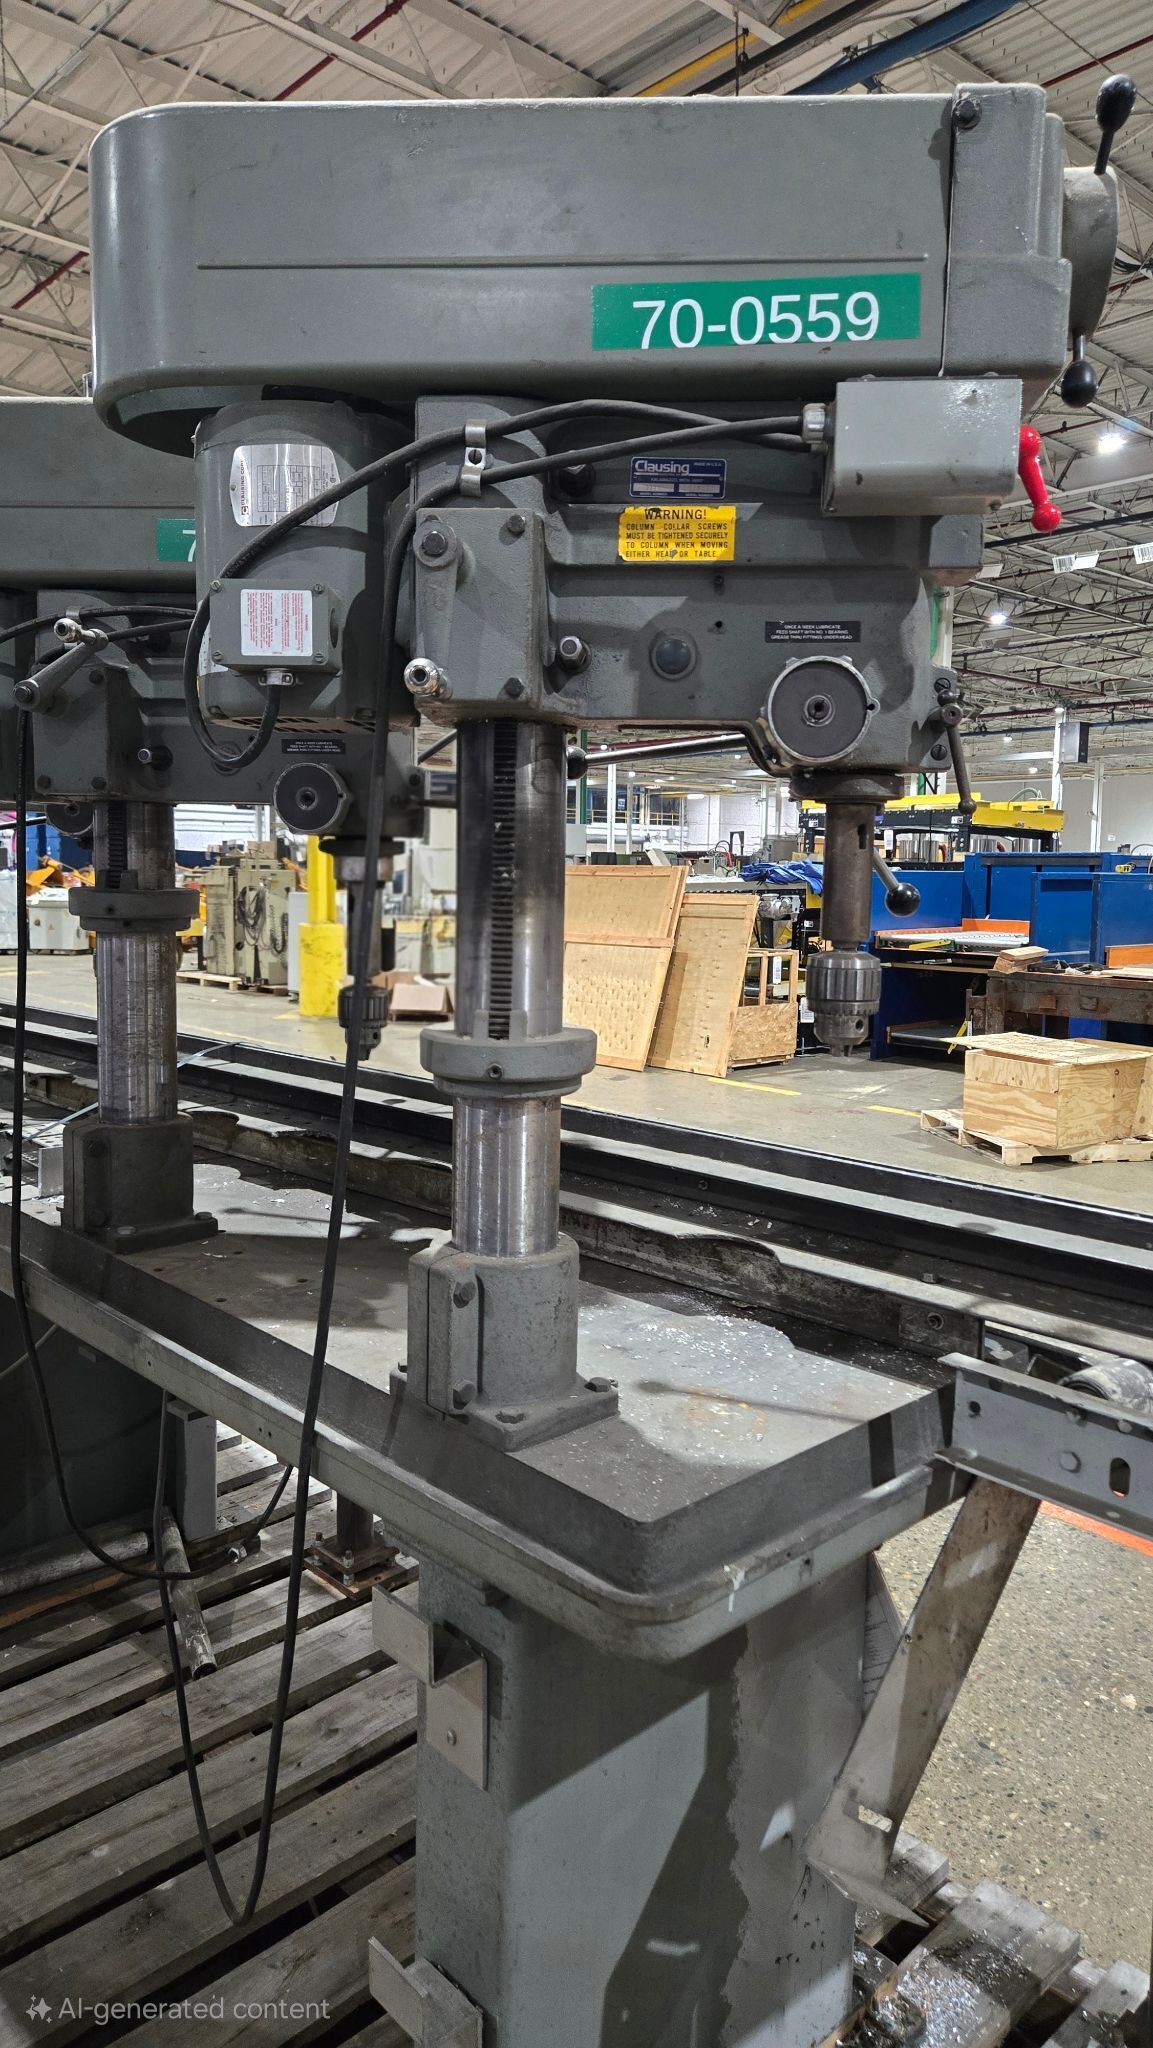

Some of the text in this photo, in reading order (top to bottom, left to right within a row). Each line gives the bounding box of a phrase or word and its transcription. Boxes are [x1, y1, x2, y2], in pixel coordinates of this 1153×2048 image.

[632, 291, 880, 350] 70-0559
[634, 460, 690, 476] Clausing
[644, 509, 707, 520] WARNING!
